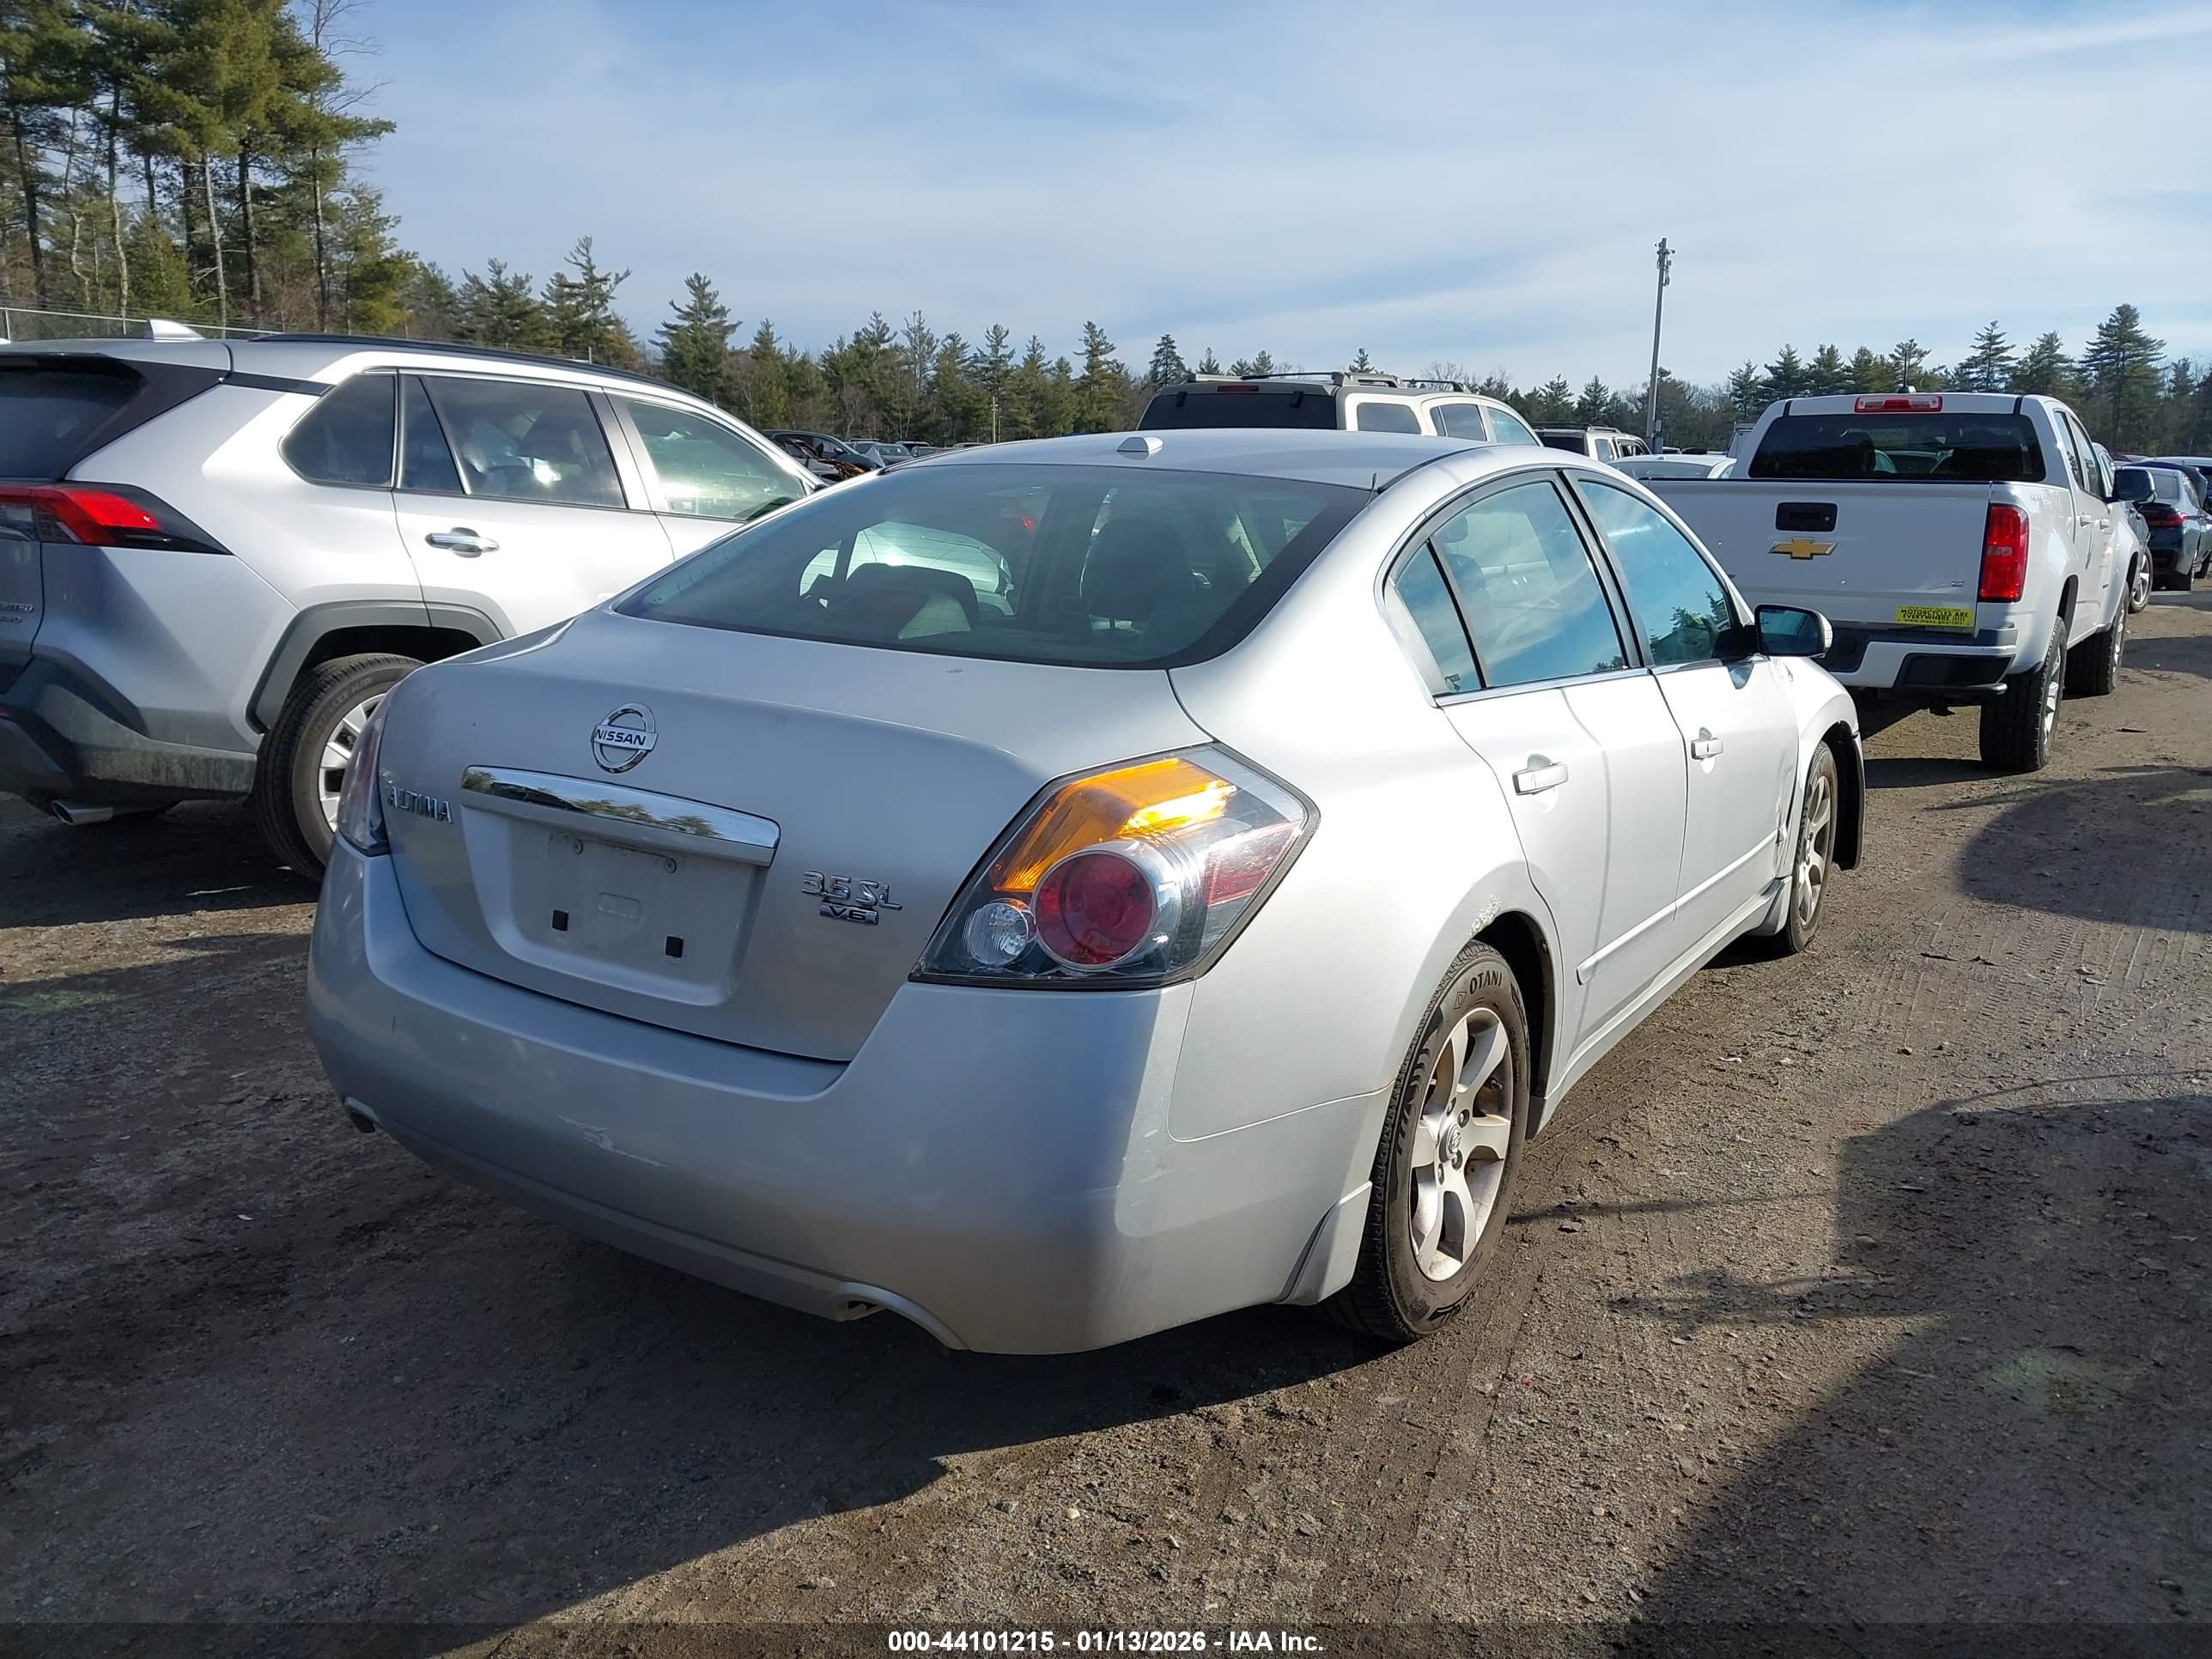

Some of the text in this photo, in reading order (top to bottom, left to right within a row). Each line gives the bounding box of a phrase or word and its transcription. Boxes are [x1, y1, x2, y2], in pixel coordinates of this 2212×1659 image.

[1900, 608, 1952, 617] MOTORCYCLES
[594, 728, 647, 746] NISSAN
[386, 785, 454, 824] ALTIMA
[824, 904, 871, 923] V6
[1469, 969, 1503, 994] OTANI
